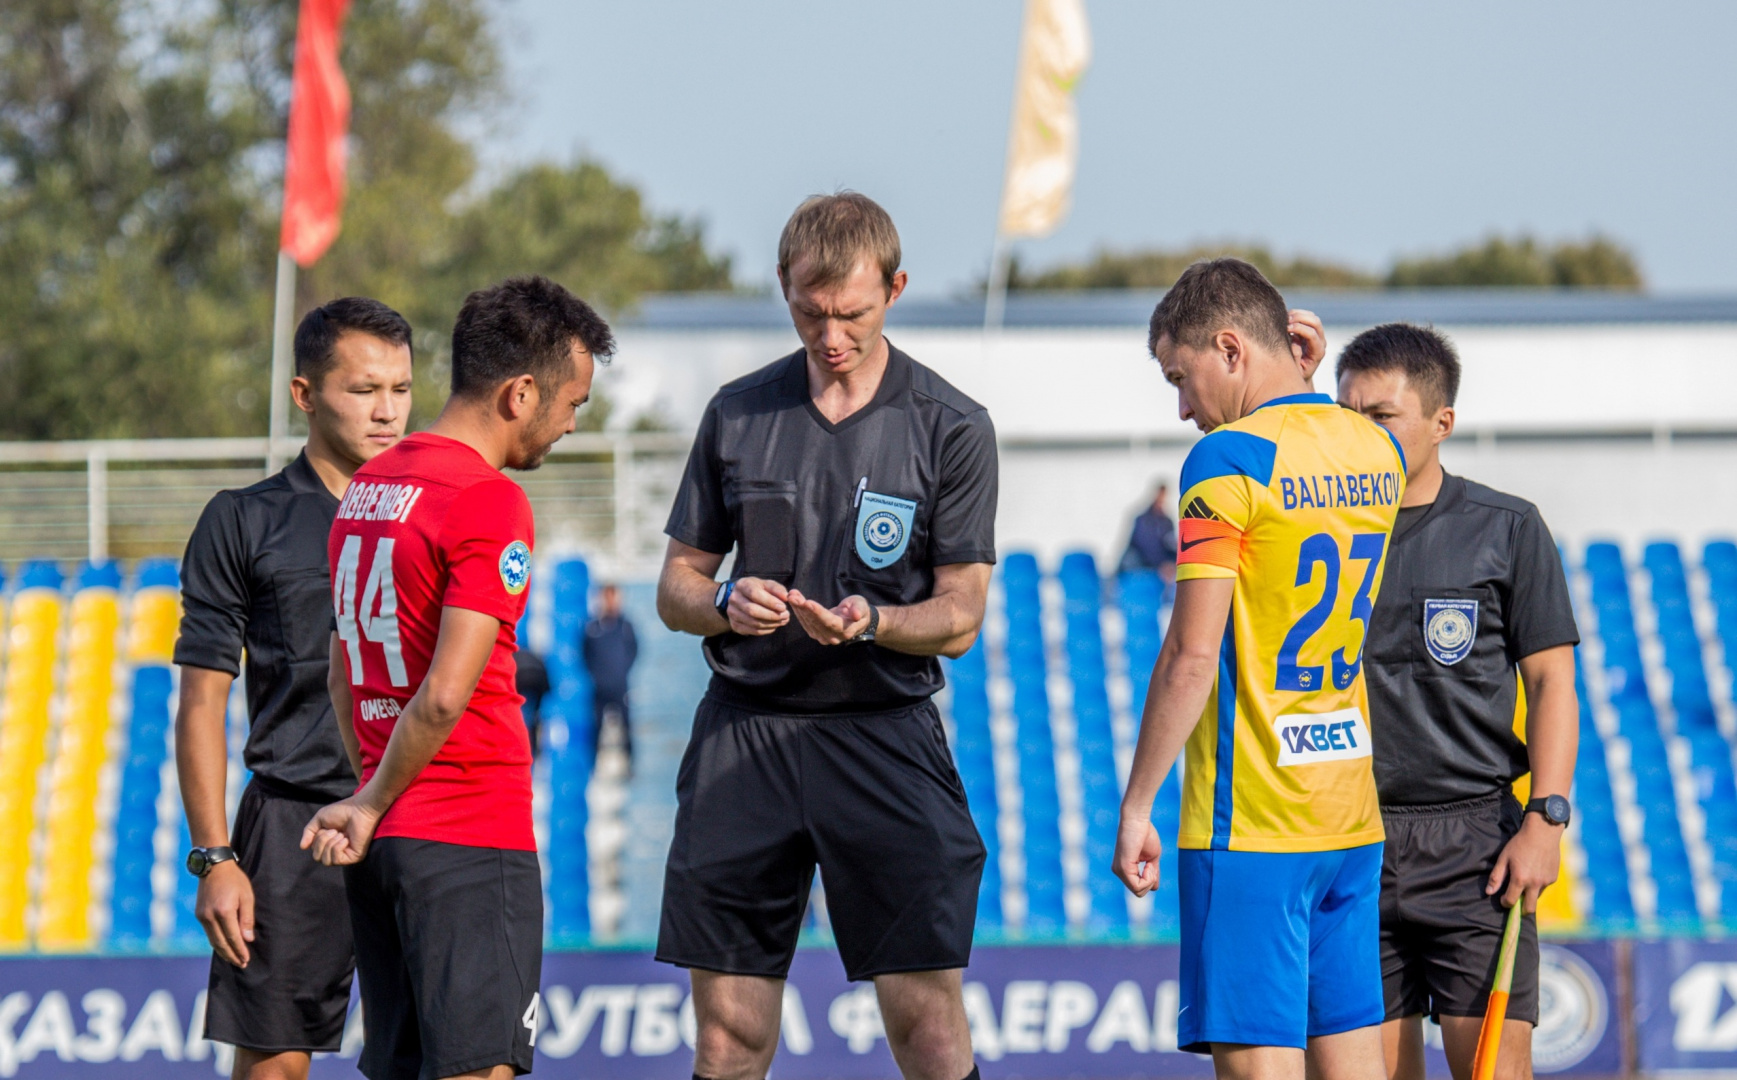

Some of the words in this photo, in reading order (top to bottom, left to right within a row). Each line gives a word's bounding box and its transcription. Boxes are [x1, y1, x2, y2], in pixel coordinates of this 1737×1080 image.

[336, 481, 424, 523] ABDENABI
[1280, 472, 1400, 510] BALTABEKOV
[334, 534, 409, 687] 44
[1274, 532, 1387, 692] 23
[360, 698, 402, 721] OMEGA
[522, 992, 540, 1047] 4
